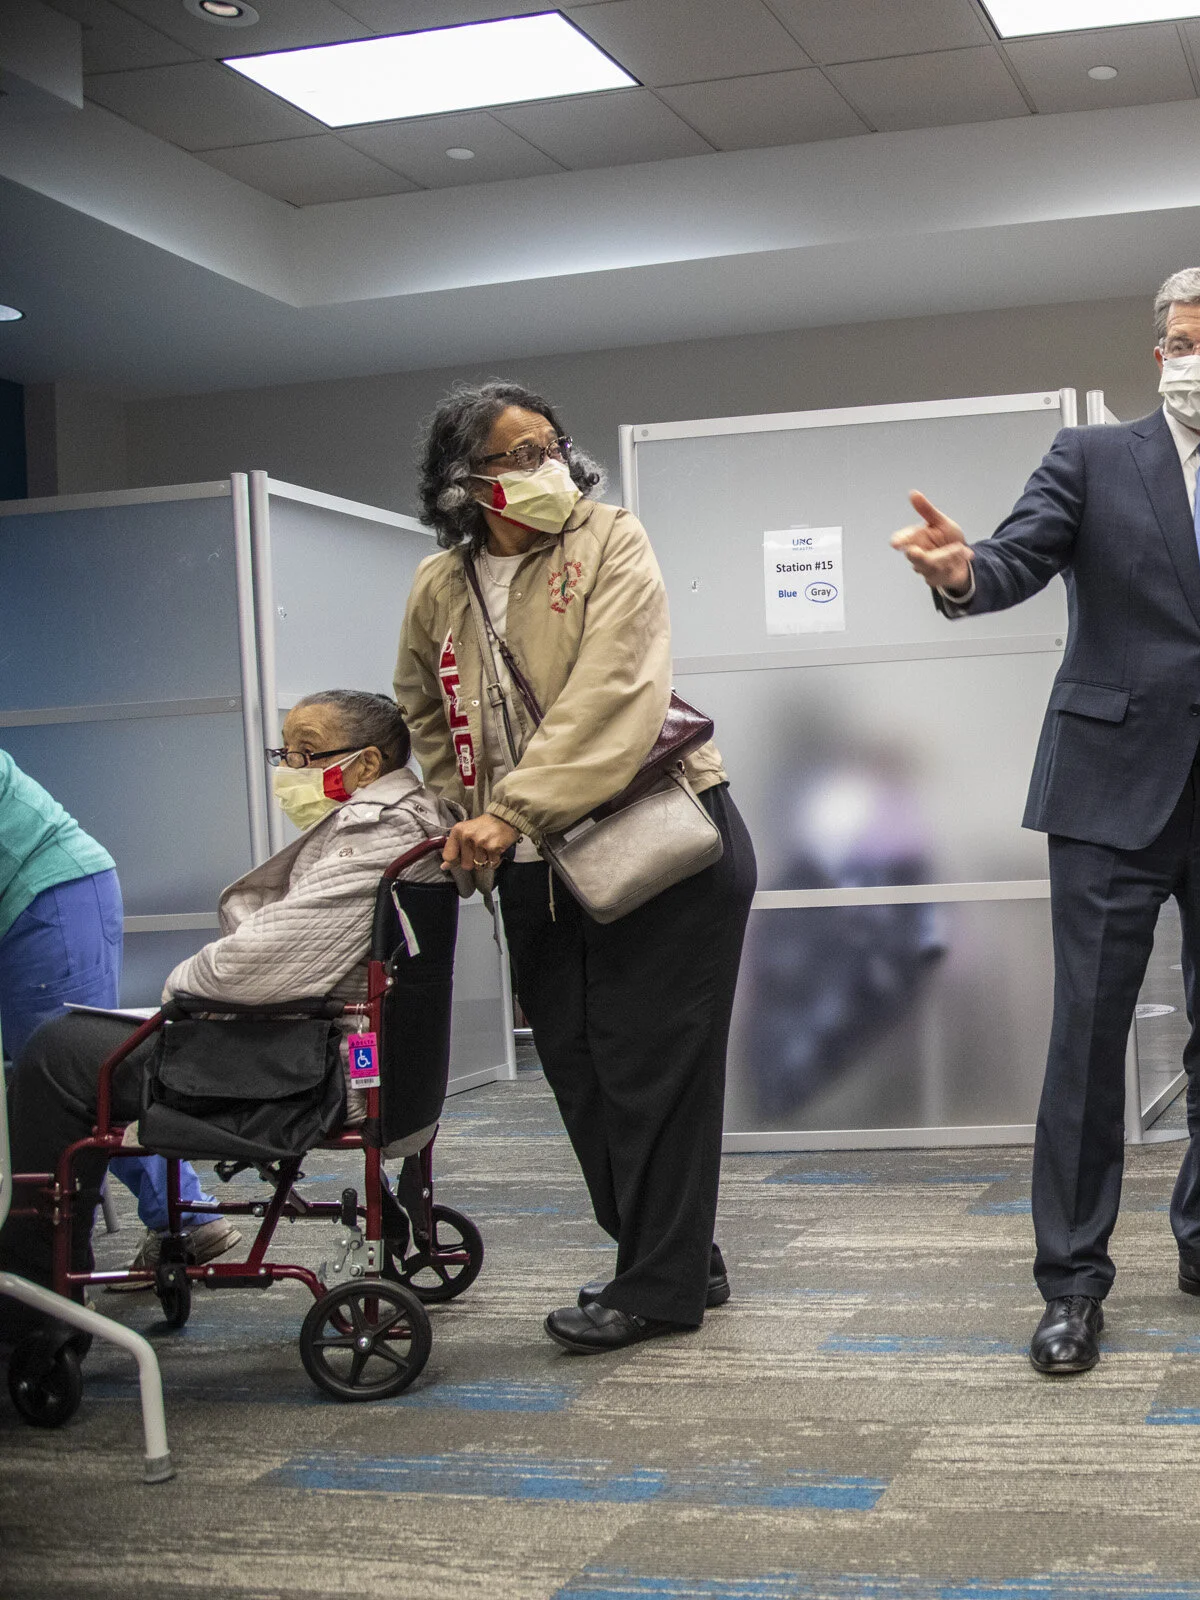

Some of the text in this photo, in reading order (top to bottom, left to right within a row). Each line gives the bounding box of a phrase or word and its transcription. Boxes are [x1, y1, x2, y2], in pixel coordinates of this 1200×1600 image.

[792, 538, 813, 546] UNC
[776, 560, 833, 573] Station #15
[778, 587, 831, 598] Blue Gray
